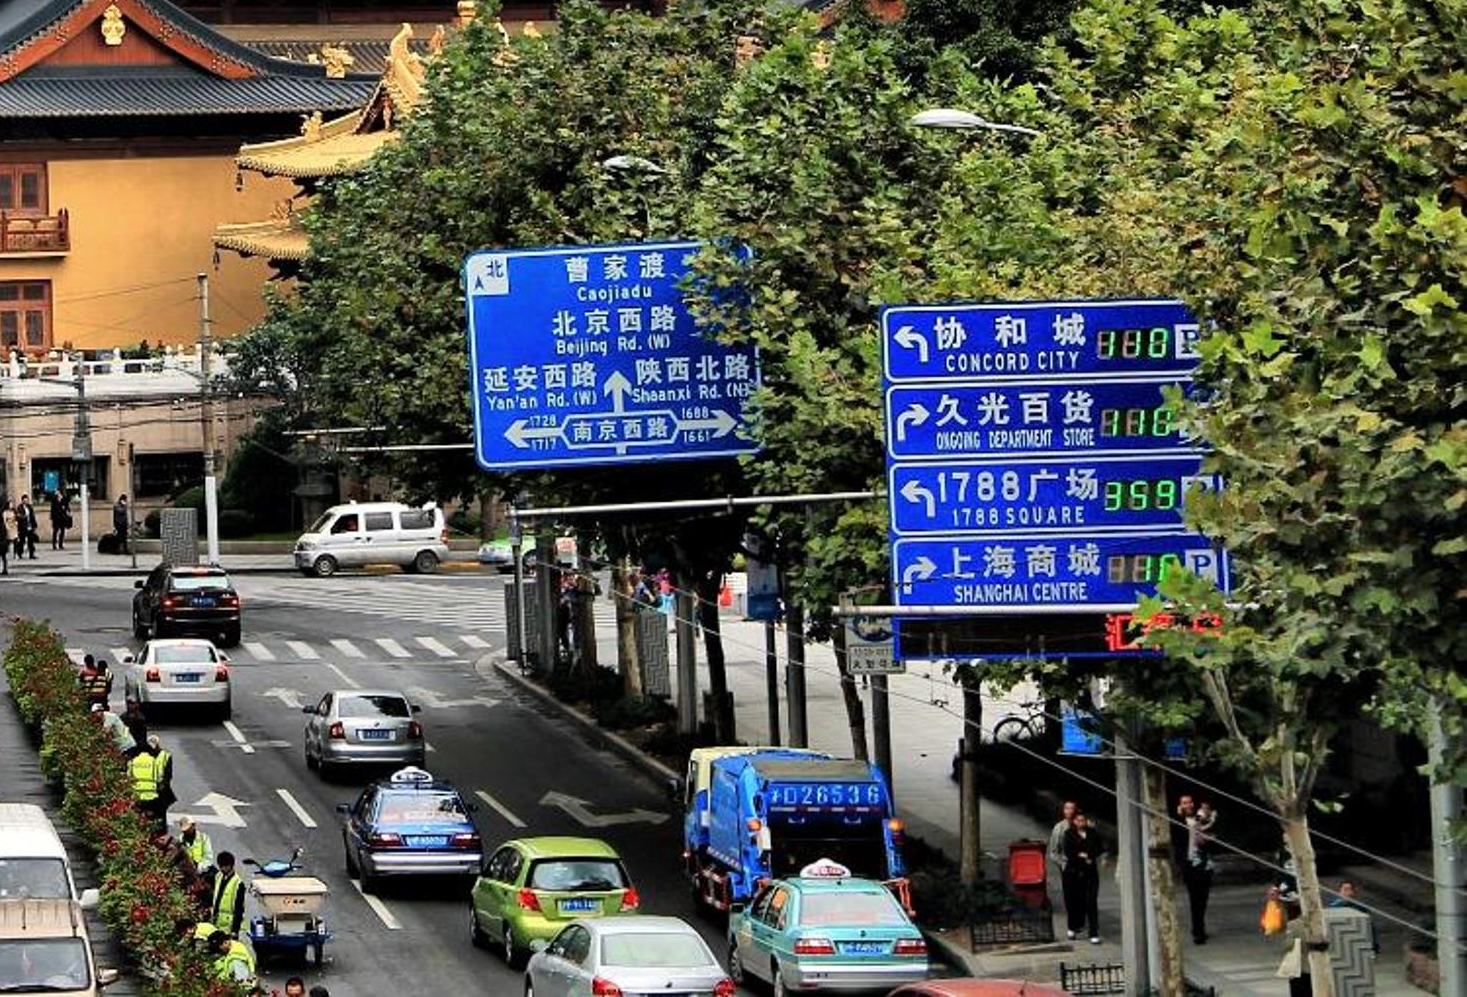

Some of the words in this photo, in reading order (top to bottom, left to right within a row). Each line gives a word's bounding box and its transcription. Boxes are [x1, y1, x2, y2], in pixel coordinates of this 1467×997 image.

[487, 260, 504, 278] 北
[565, 253, 665, 282] 曹家渡
[577, 285, 652, 304] Caojiadu
[552, 305, 677, 337] 北京西路
[933, 312, 1086, 350] 协和城
[557, 339, 607, 357] Beijing
[635, 353, 749, 385] 陕西北路
[946, 353, 1029, 372] CONCORD
[1038, 351, 1080, 369] CITY
[483, 361, 597, 393] 延安西路
[486, 395, 538, 410] Yan'an
[632, 384, 691, 403] Shaanxi
[682, 406, 709, 419] 1688
[935, 390, 1094, 426] 久光百货
[530, 414, 556, 427] 1728
[573, 417, 667, 442] 南京西路
[532, 437, 556, 450] 1717
[683, 430, 709, 442] 1661
[989, 429, 1052, 448] DEPARTMENT
[1063, 428, 1095, 446] STORE
[938, 468, 1098, 502] 1788广场
[1105, 480, 1175, 511] 359
[953, 508, 998, 526] 1788
[1006, 506, 1084, 524] SQUARE
[942, 543, 1101, 578] 上海商城
[1192, 555, 1211, 576] P
[954, 584, 1027, 602] SHANGHAI
[1033, 582, 1087, 601] CENTRE
